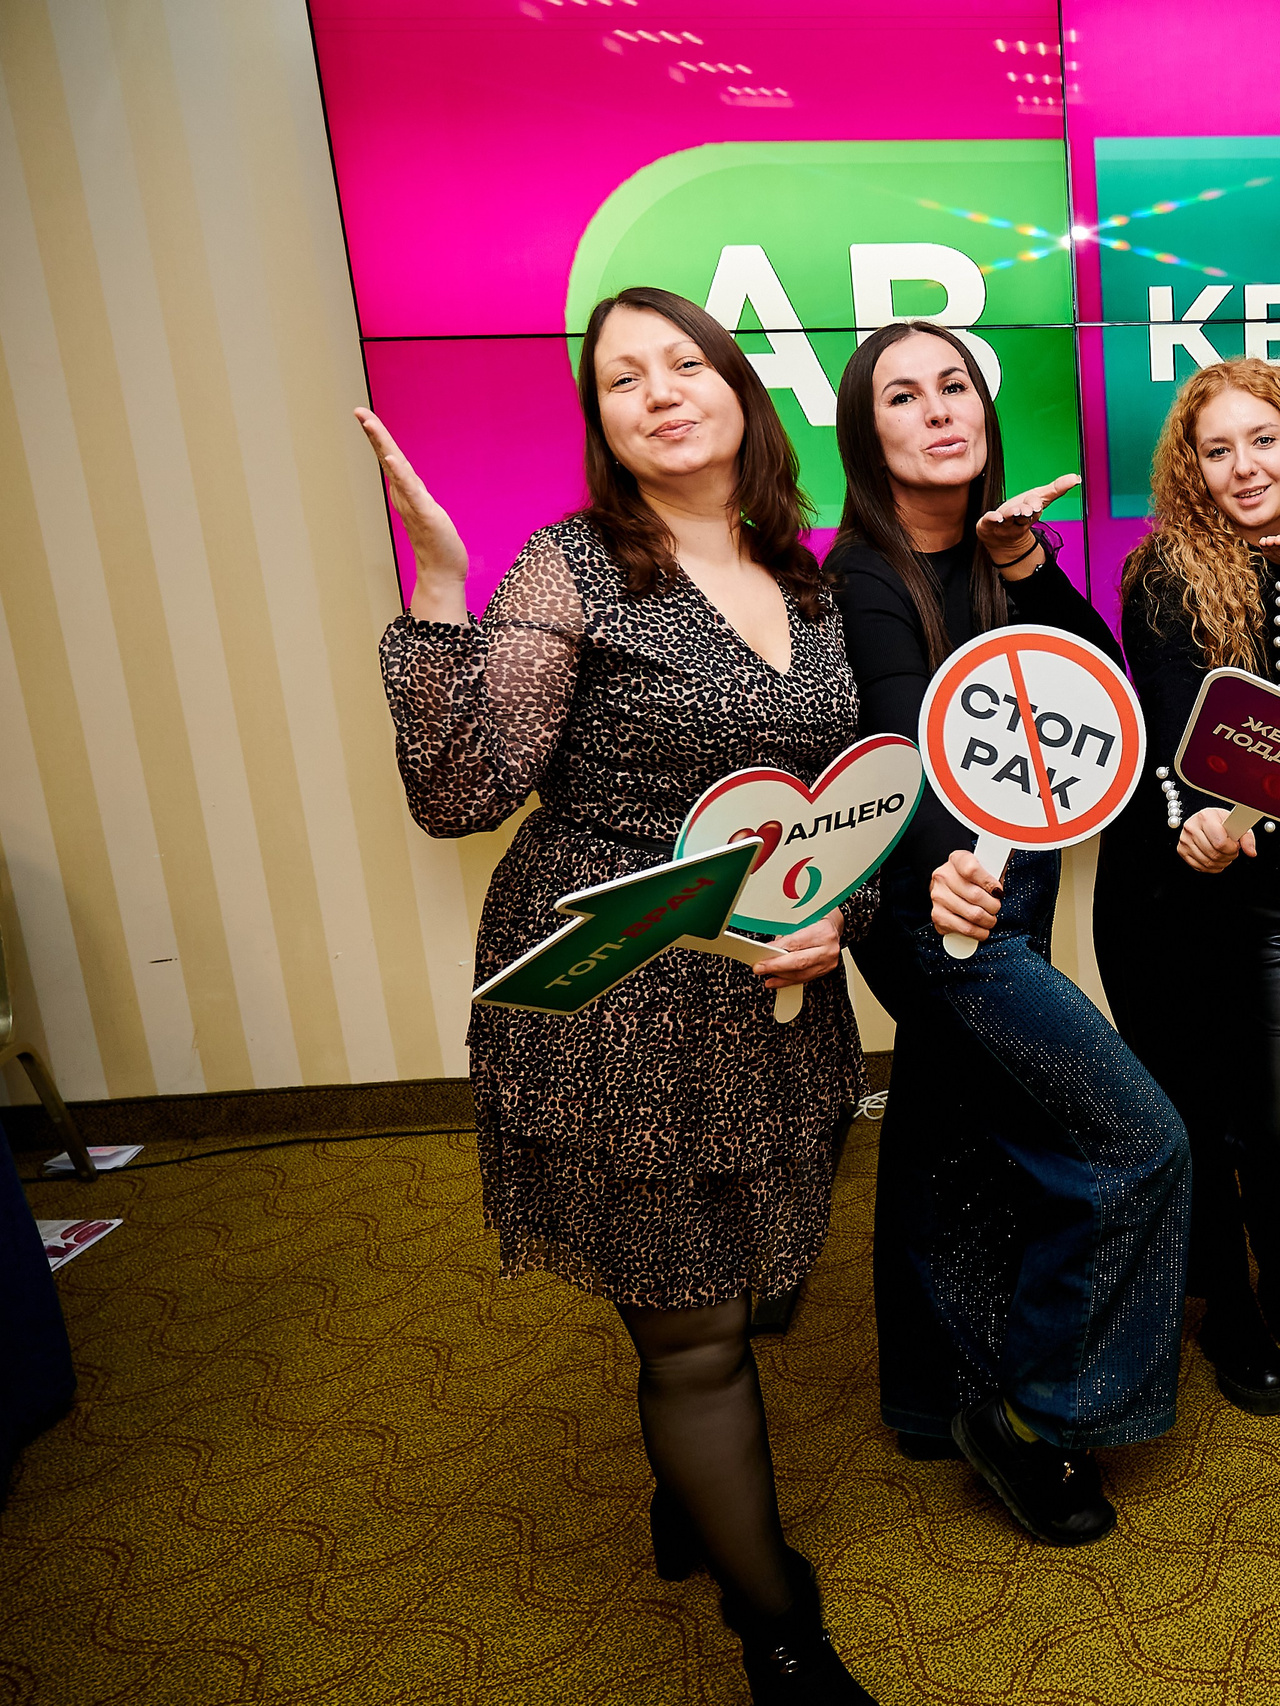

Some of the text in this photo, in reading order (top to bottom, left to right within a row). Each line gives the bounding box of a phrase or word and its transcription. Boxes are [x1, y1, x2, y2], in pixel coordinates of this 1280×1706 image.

[960, 682, 1116, 768] СТОП
[960, 736, 1082, 810] РАК
[784, 793, 904, 846] АЛЦЕЮ
[545, 877, 716, 989] ТОП-ВРАЧ
